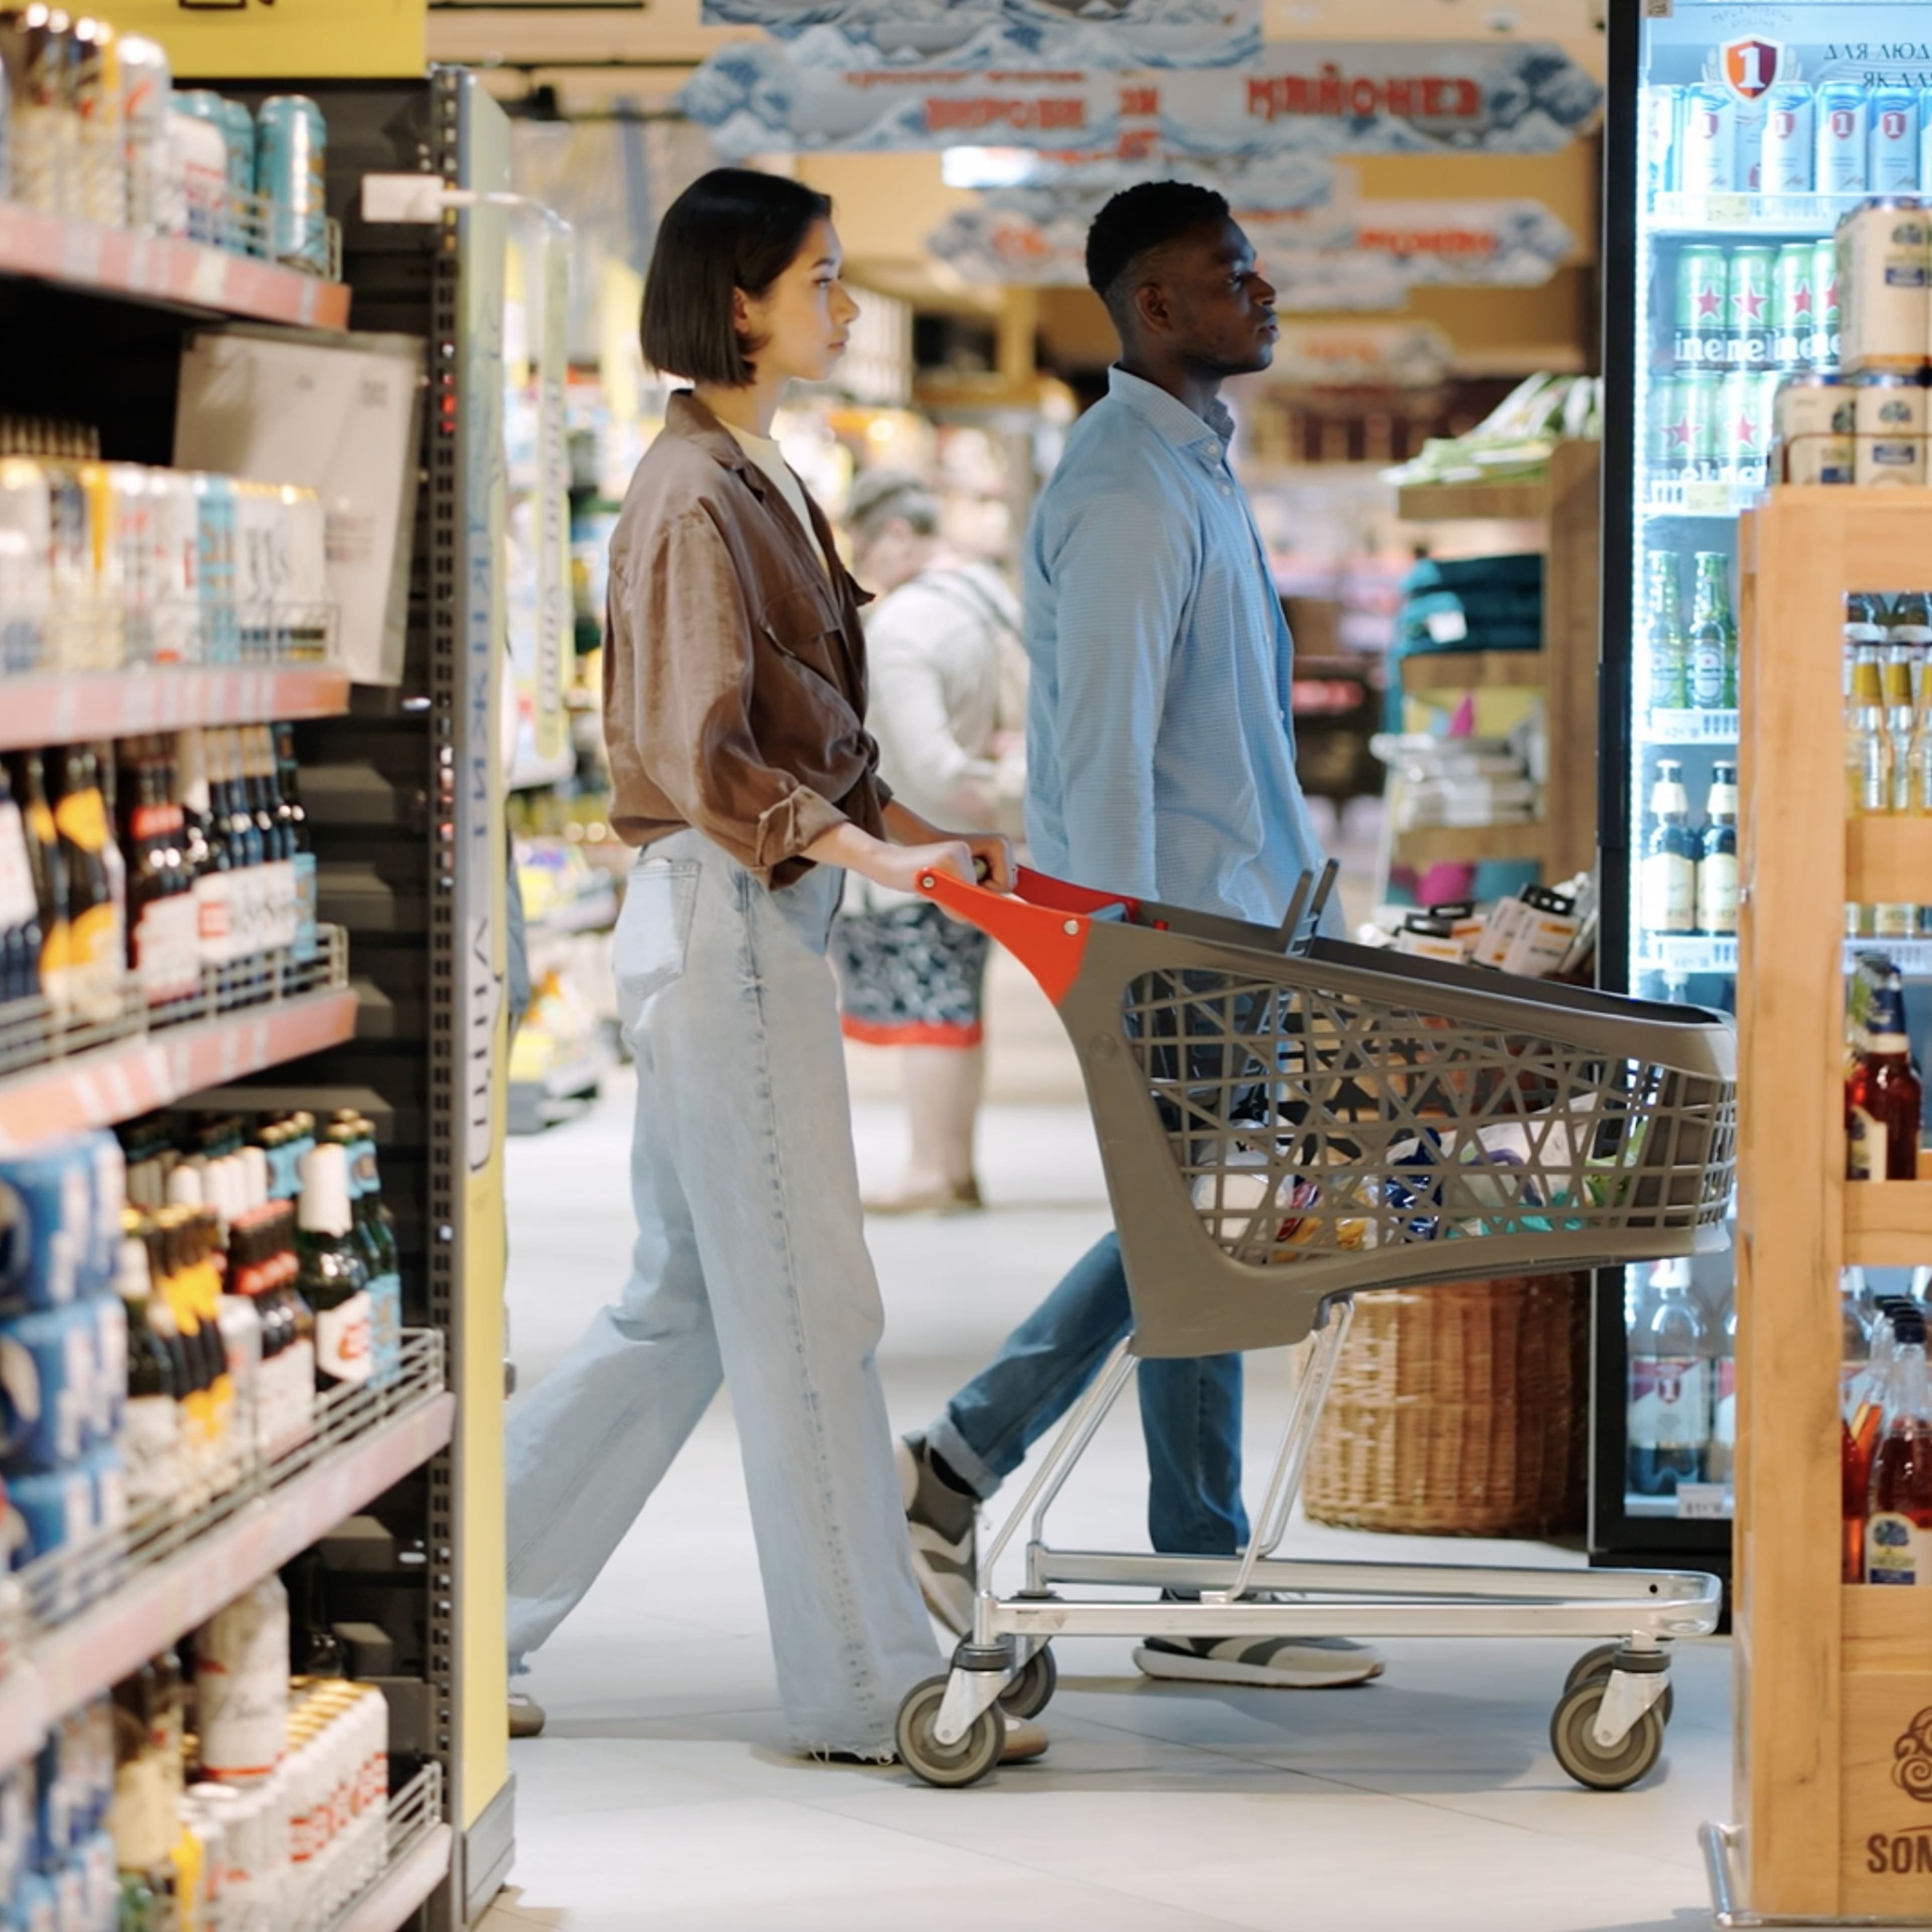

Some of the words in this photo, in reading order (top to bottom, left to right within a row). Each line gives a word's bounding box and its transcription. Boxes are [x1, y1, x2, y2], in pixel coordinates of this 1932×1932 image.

[1823, 43, 1868, 60] ДЛЯ
[1876, 42, 1932, 60] ЛЮД
[1738, 48, 1765, 89] 1
[1863, 71, 1888, 88] ЯК
[1896, 72, 1932, 89] ДЛ
